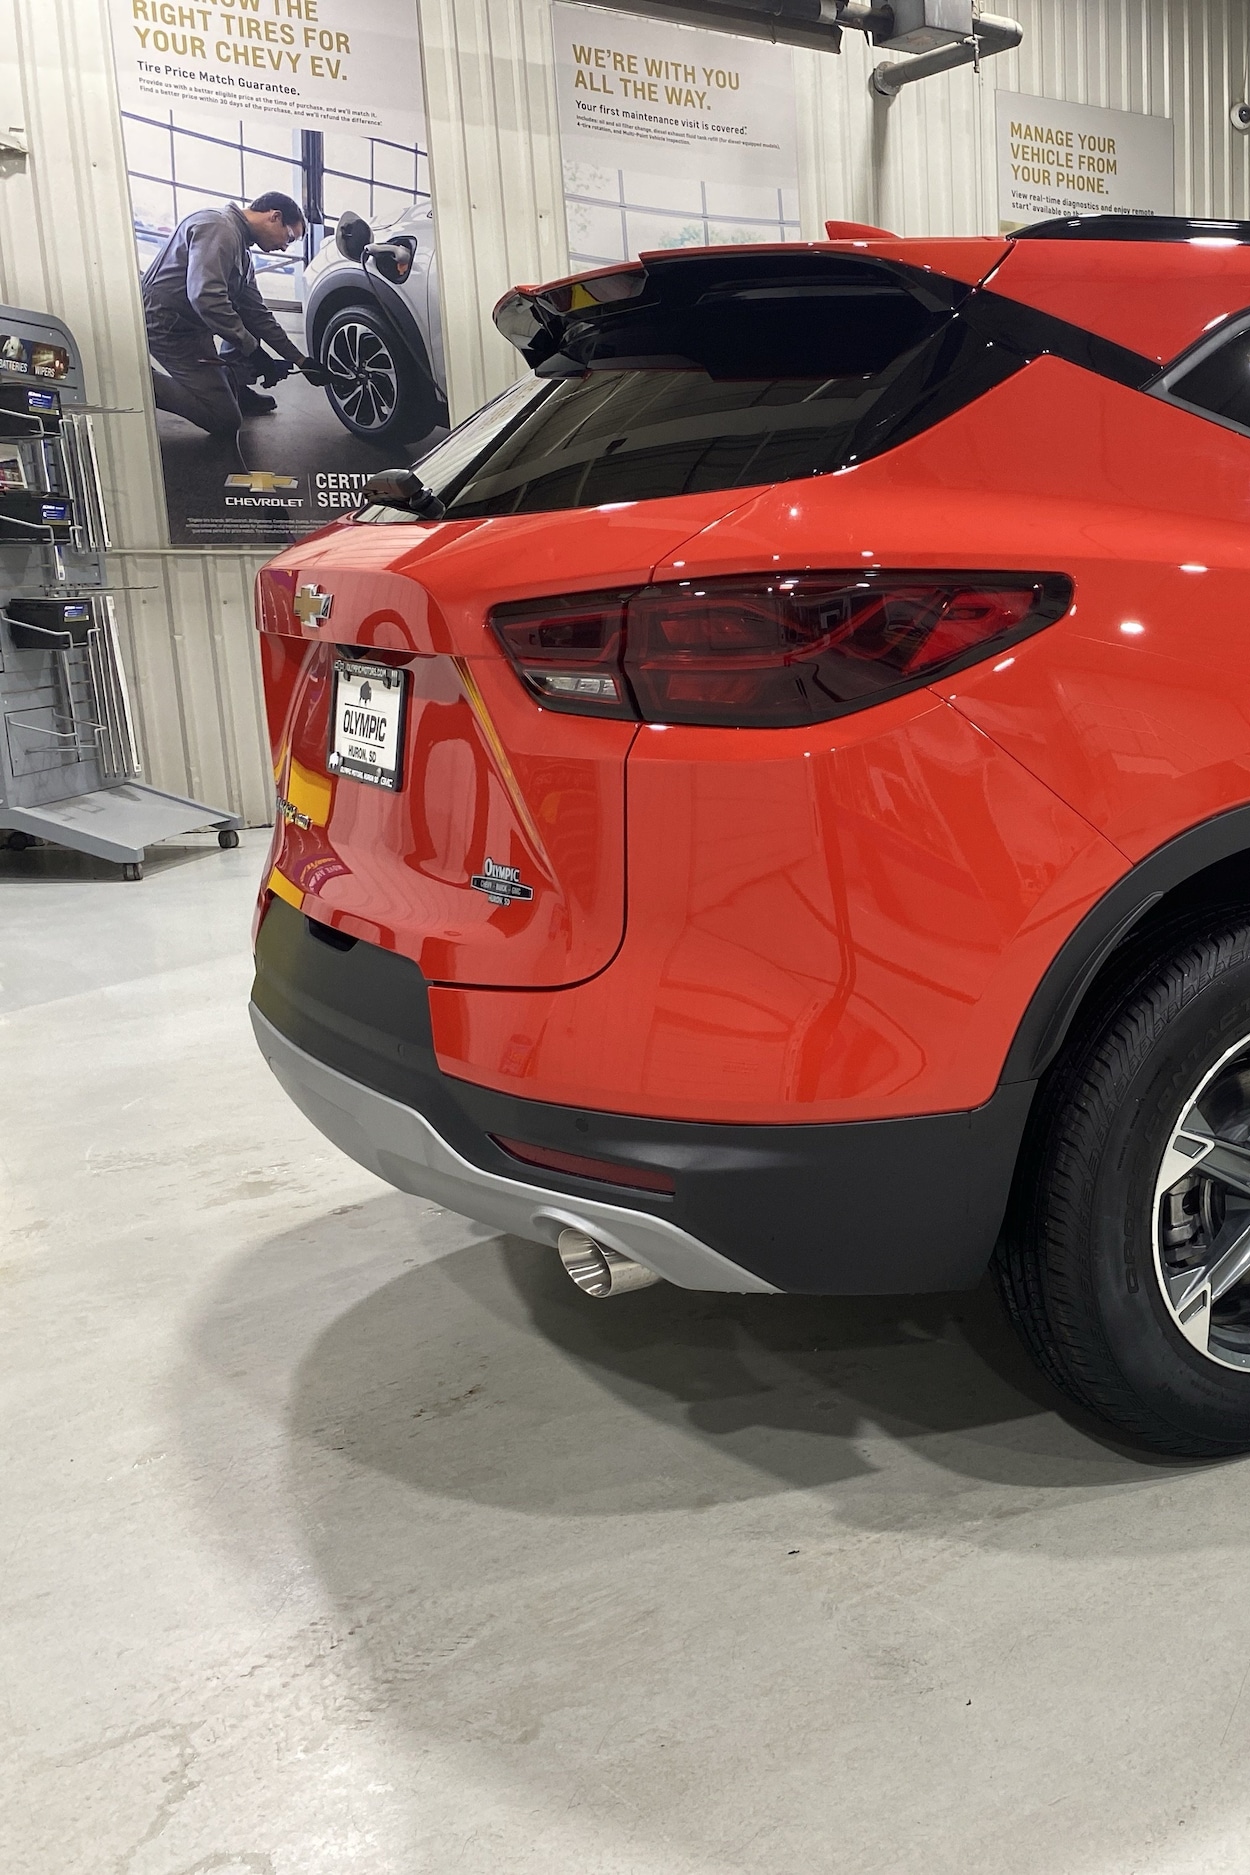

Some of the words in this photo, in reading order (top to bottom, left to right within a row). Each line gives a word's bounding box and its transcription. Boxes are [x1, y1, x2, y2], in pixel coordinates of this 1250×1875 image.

[132, 0, 212, 32] RIGHT
[220, 13, 295, 45] TIRES
[303, 27, 351, 54] FOR
[133, 25, 207, 59] YOUR
[215, 41, 301, 73] CHEVY
[310, 55, 348, 80] EV.
[572, 43, 638, 75] WE'RE
[644, 57, 696, 85] WITH
[702, 67, 741, 91] YOU
[137, 60, 161, 73] Tire
[165, 65, 195, 79] Price
[199, 71, 234, 86] Match
[238, 77, 300, 96] Guarantee.
[574, 69, 614, 95] ALL
[619, 78, 659, 103] THE
[664, 85, 712, 111] WAY.
[139, 77, 163, 87] Provide
[174, 82, 187, 91] with
[194, 85, 214, 95] better
[215, 89, 237, 99] eligible
[238, 93, 254, 102] price
[352, 109, 370, 118] match
[139, 85, 154, 93] Find
[160, 88, 180, 97] better
[181, 92, 198, 101] price
[198, 94, 218, 104] within
[229, 100, 243, 108] days
[320, 113, 340, 121] refund
[575, 99, 597, 112] Your
[599, 104, 620, 117] first
[622, 110, 679, 126] maintenance
[680, 119, 700, 129] visit
[701, 121, 709, 131] is
[1010, 121, 1074, 148] MANAGE
[1077, 133, 1116, 155] YOUR
[1010, 142, 1074, 169] VEHICLE
[1078, 154, 1117, 175] FROM
[1010, 163, 1051, 186] YOUR
[1056, 171, 1109, 195] PHONE.
[1011, 189, 1028, 199] View
[1029, 194, 1061, 205] real-time
[1062, 198, 1100, 210] diagnostics
[1100, 204, 1112, 212] and
[1113, 206, 1131, 215] enjoy
[1131, 208, 1155, 216] remote
[1032, 205, 1062, 216] available
[0, 359, 28, 373] BATTERIES
[34, 365, 56, 378] WIPERS
[225, 497, 304, 508] CHEVROLET
[343, 709, 387, 742] OLYMPIC
[348, 744, 368, 761] HURON,
[369, 750, 377, 763] SD
[380, 776, 393, 788] GMC
[484, 857, 520, 882] OLYMPIC
